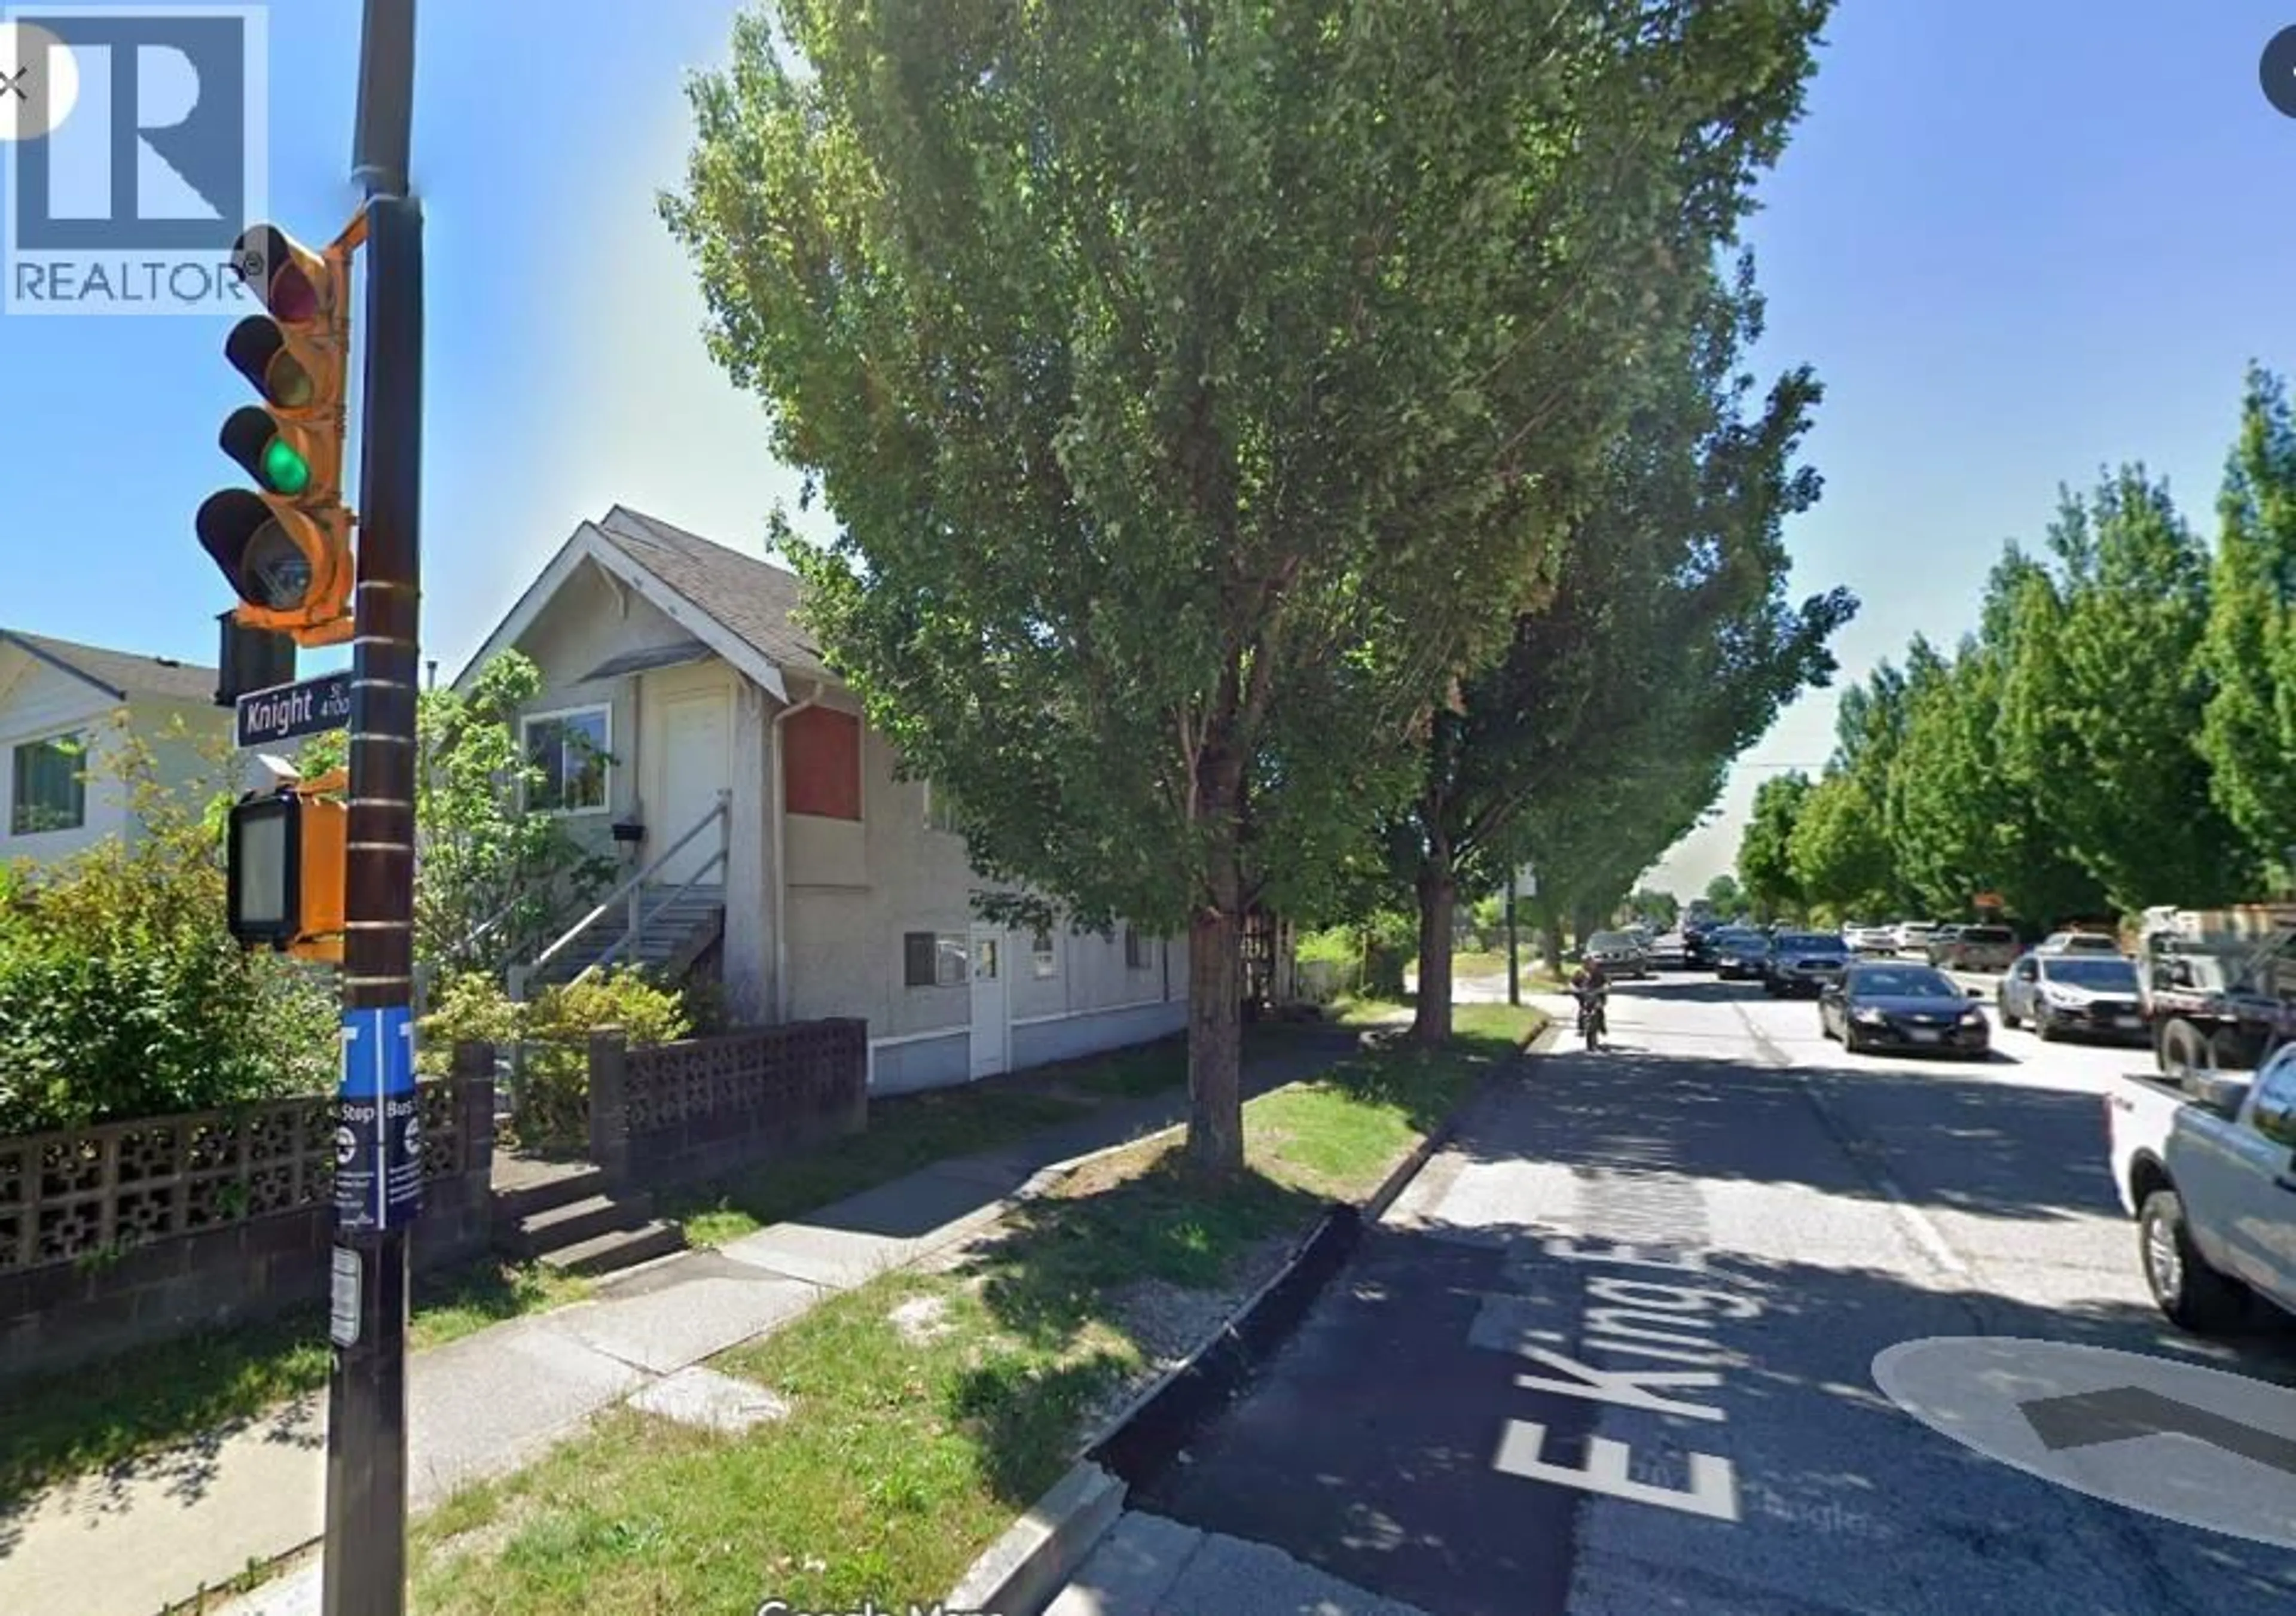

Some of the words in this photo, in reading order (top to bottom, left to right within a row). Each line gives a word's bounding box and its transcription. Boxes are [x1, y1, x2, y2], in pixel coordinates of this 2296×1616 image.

[247, 688, 312, 736] Knight
[1513, 1275, 1762, 1422] King
[1494, 1417, 1741, 1522] E
